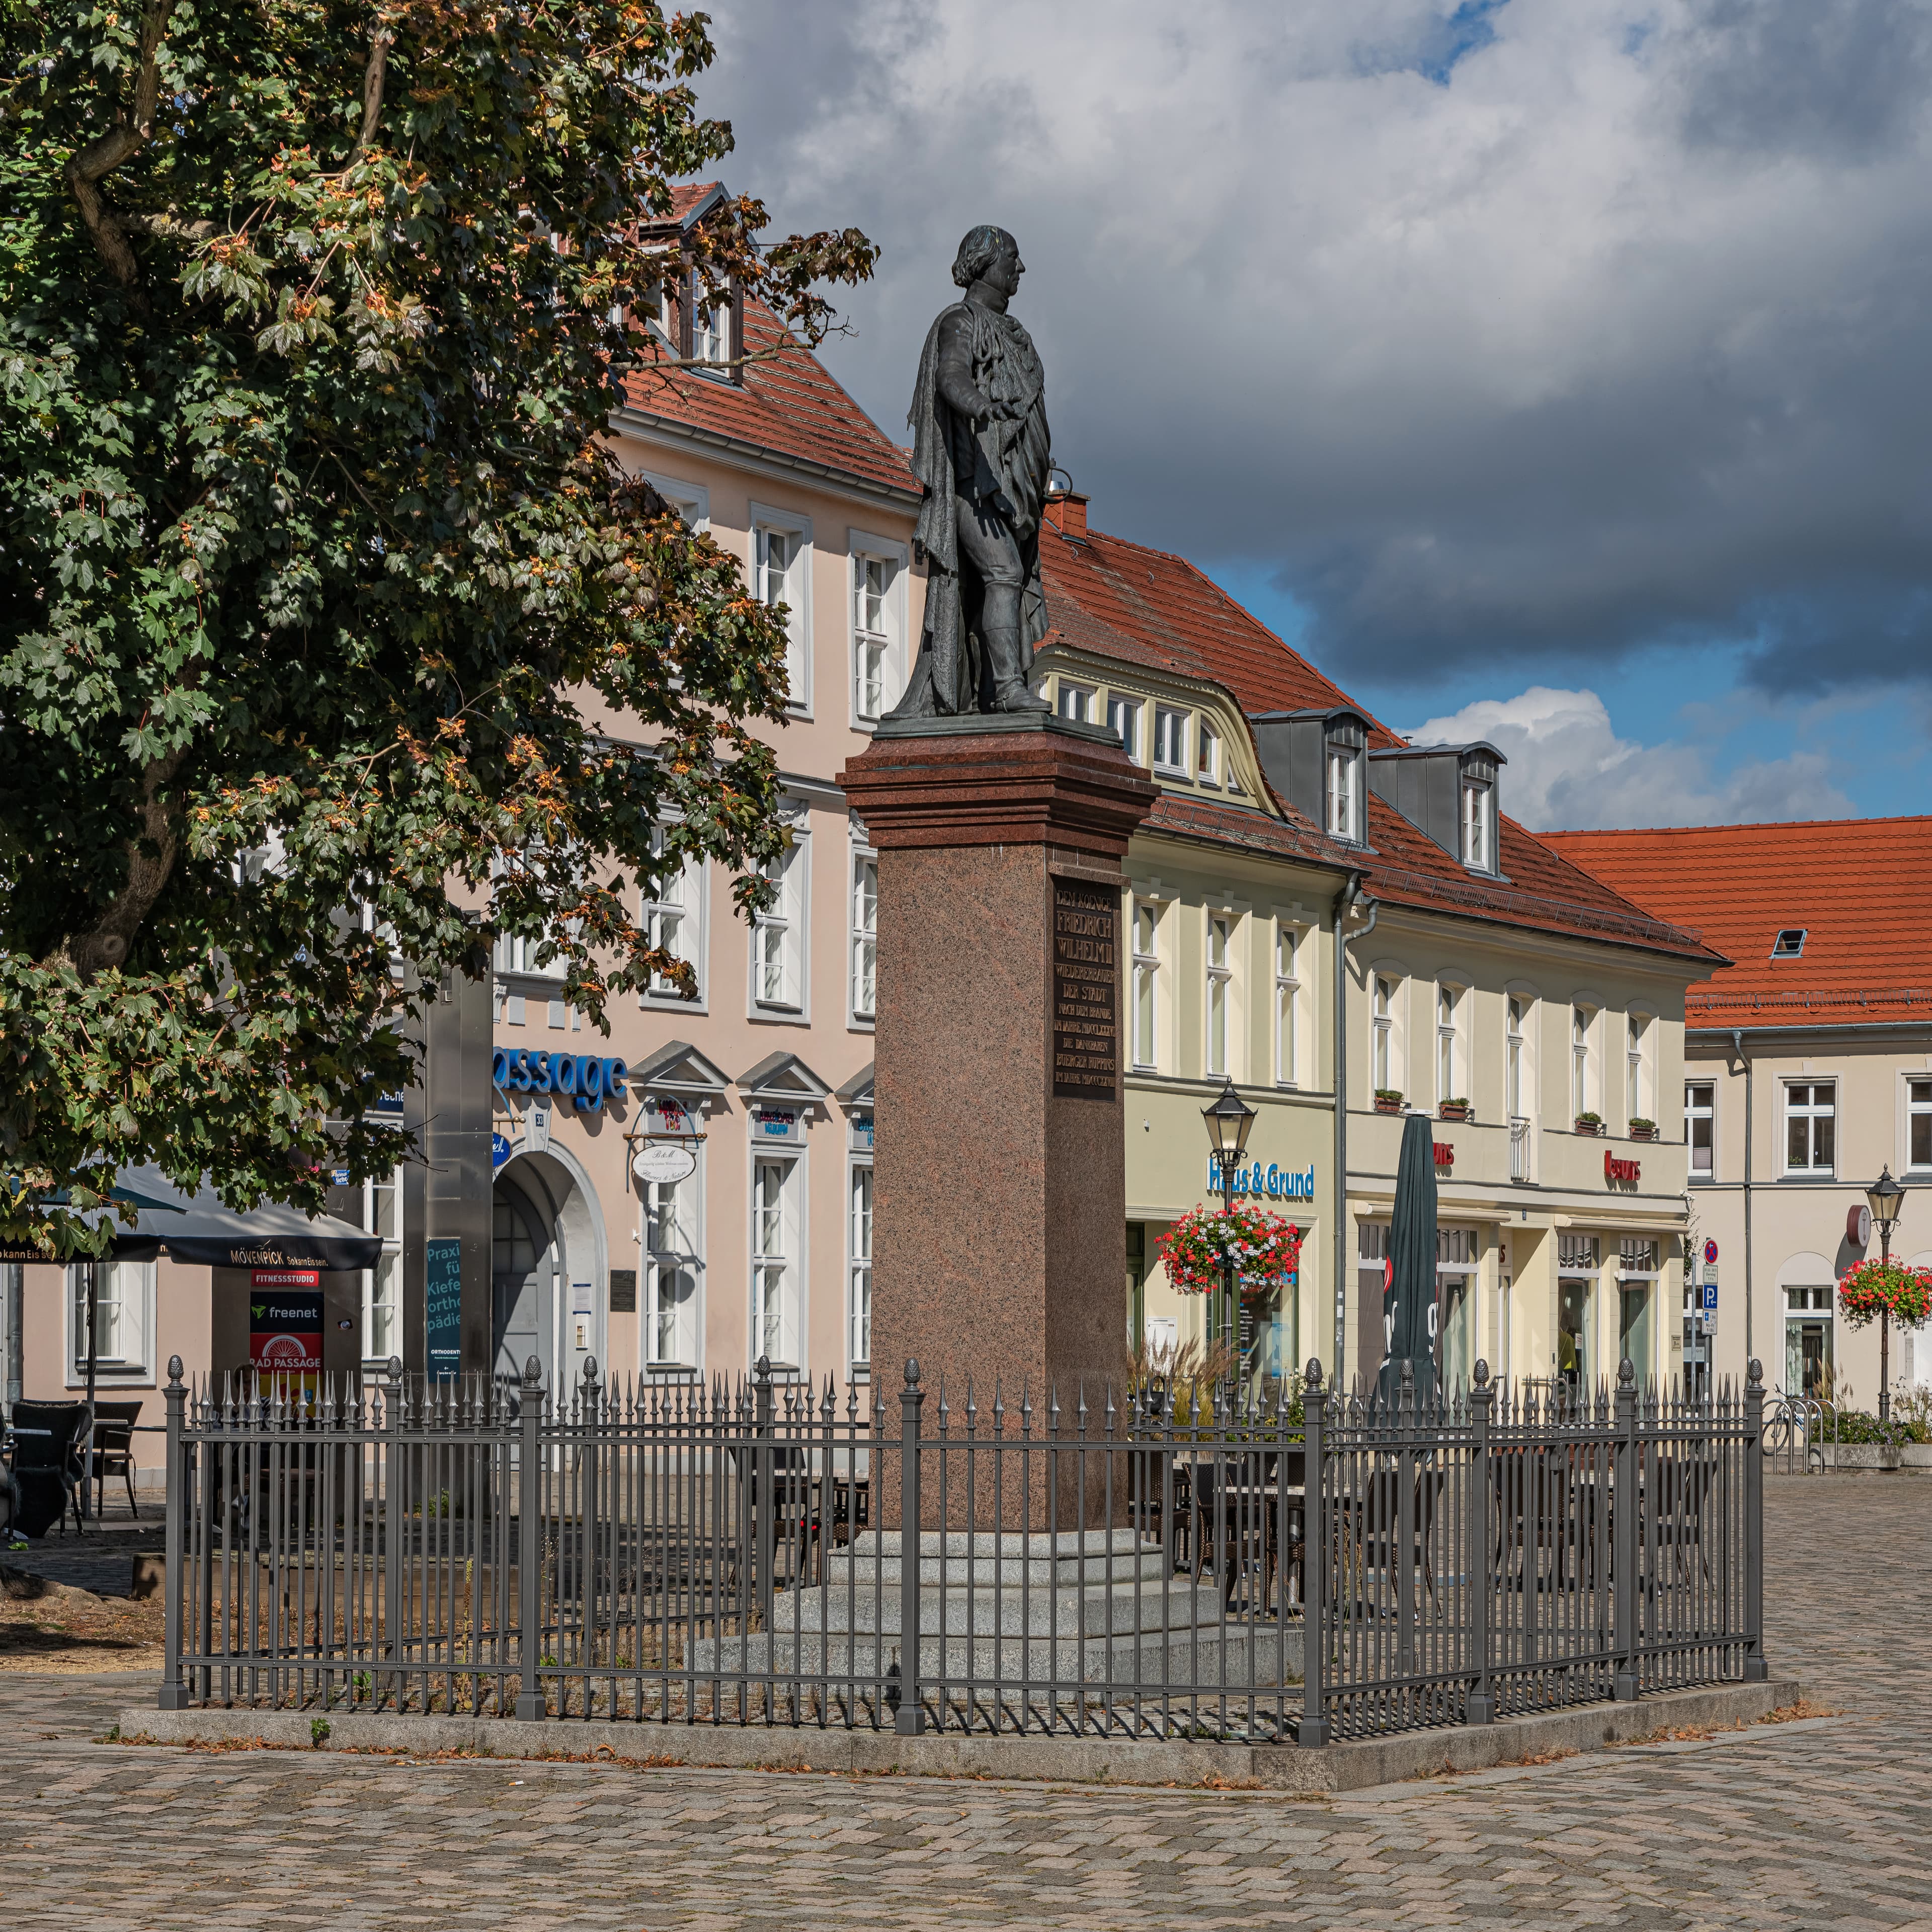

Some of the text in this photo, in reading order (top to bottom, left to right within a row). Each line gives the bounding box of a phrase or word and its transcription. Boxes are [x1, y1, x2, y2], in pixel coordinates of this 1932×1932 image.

[1057, 890, 1111, 912] DEM KOENIGE
[1057, 911, 1111, 938] FRIEDRICH
[1056, 937, 1105, 963] WILHELM
[1063, 984, 1107, 1002] DER STADT
[1059, 1003, 1075, 1015] NACH
[1076, 1005, 1088, 1017] DEM
[1063, 1038, 1073, 1049] DIE
[1057, 1053, 1115, 1071] BUERGER RUPPINS
[493, 1046, 628, 1114] assage
[536, 1115, 543, 1125] 33
[1433, 1143, 1455, 1165] uns
[1604, 1150, 1641, 1180] bruns
[641, 1170, 661, 1180] Flowers
[1207, 1157, 1314, 1196] Hus & Grund
[4, 1249, 25, 1259] kann
[27, 1250, 39, 1258] Eis
[230, 1247, 284, 1264] MÖVENPICK
[287, 1256, 295, 1265] So
[295, 1257, 307, 1266] kann
[315, 1258, 329, 1266] sein.
[428, 1243, 460, 1262] Praxi
[446, 1261, 460, 1275] fü
[256, 1274, 314, 1282] FITNESSSTUDIO
[427, 1278, 461, 1296] Kiefe
[1707, 1287, 1715, 1306] P
[269, 1307, 318, 1318] freenet
[274, 1358, 321, 1367] PASSAGE
